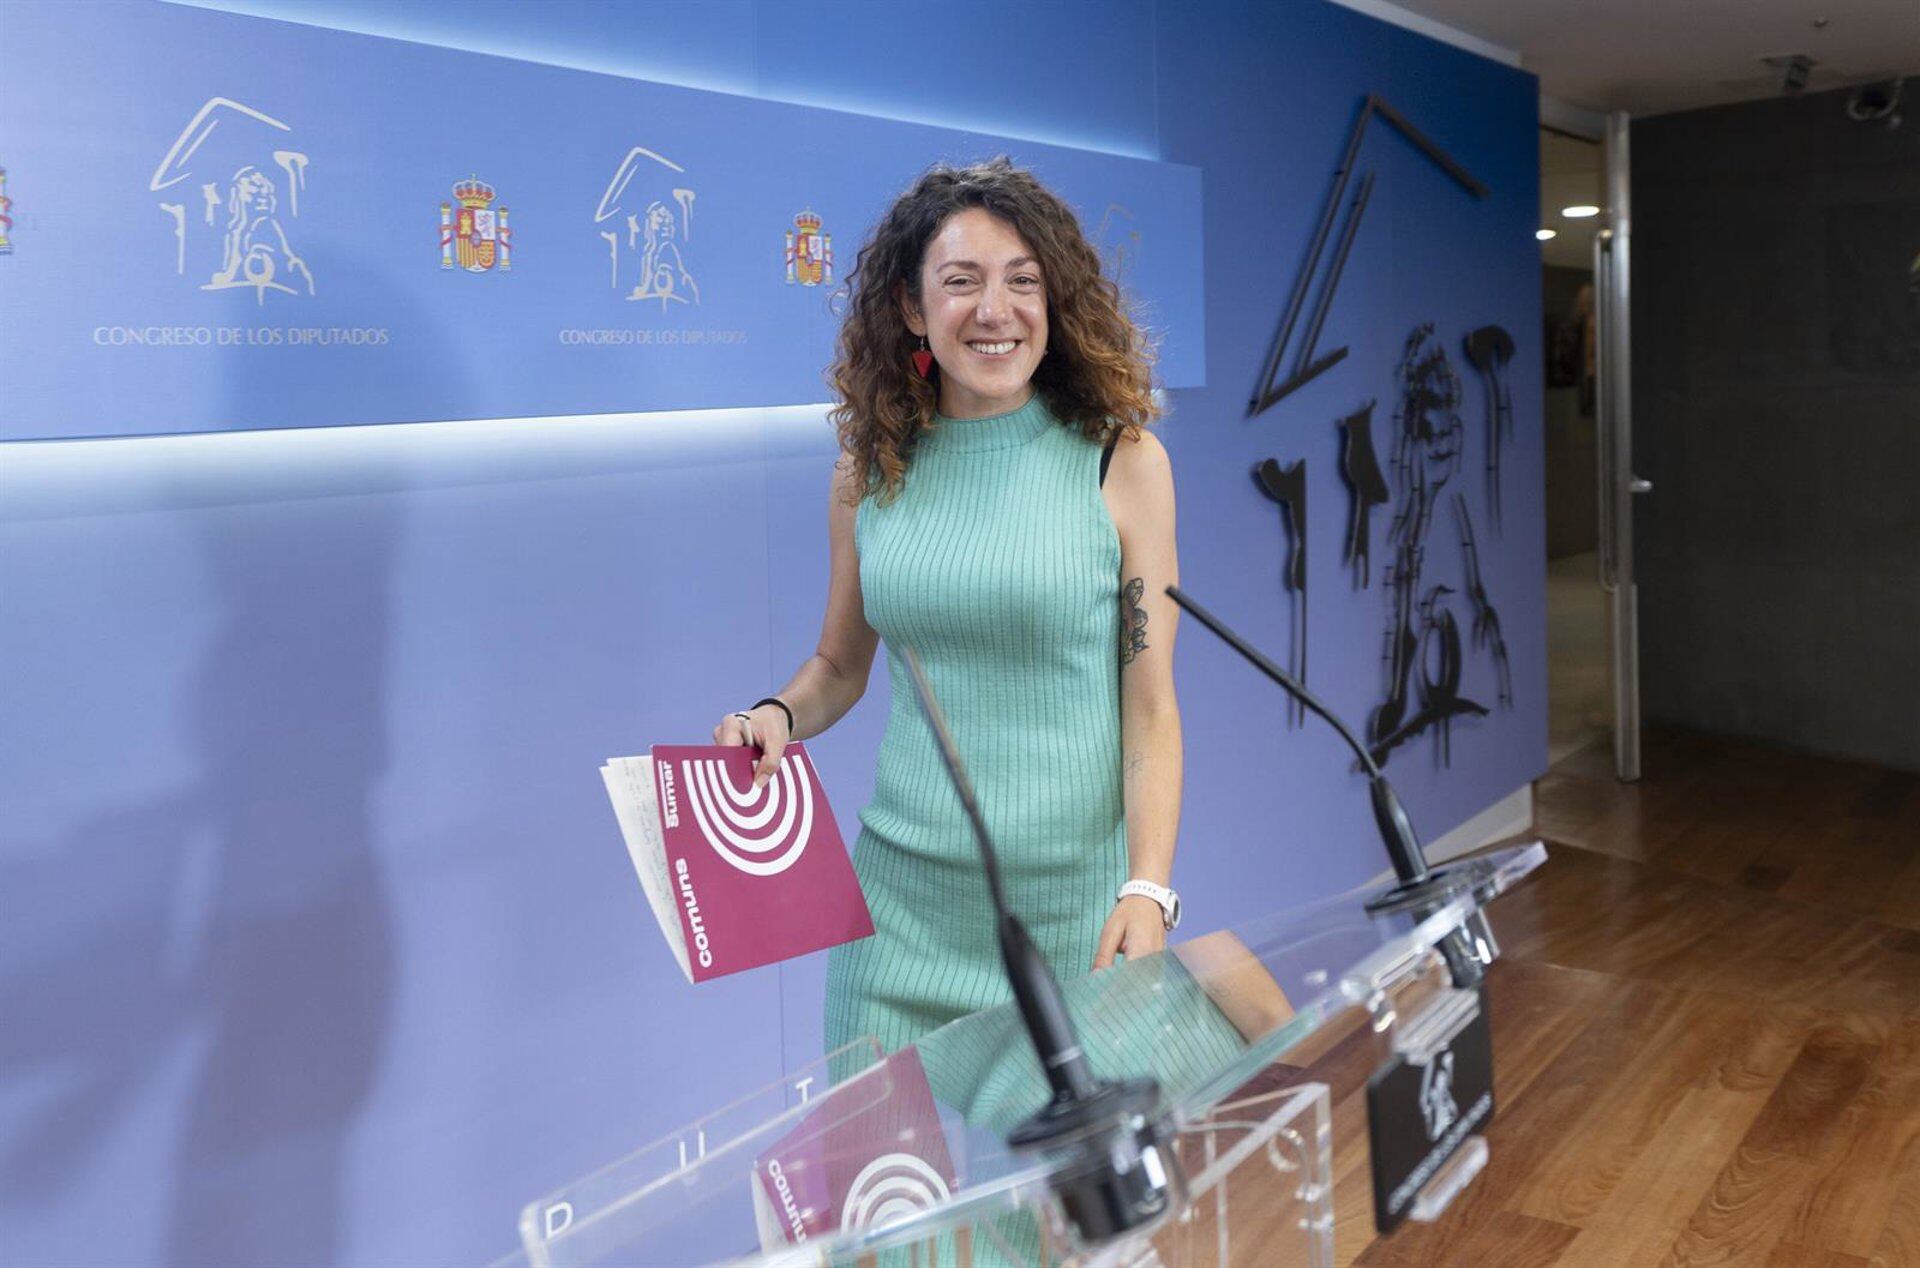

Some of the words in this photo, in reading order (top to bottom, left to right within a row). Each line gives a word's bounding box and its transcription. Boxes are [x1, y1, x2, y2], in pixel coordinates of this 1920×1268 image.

[93, 327, 212, 345] CONGRESO
[216, 327, 241, 345] DE
[249, 327, 283, 345] LOS
[288, 327, 389, 345] DIPUTADOS
[559, 329, 634, 345] CONGRESO
[637, 329, 653, 345] DE
[656, 329, 680, 345] LOS
[675, 858, 712, 968] comuns
